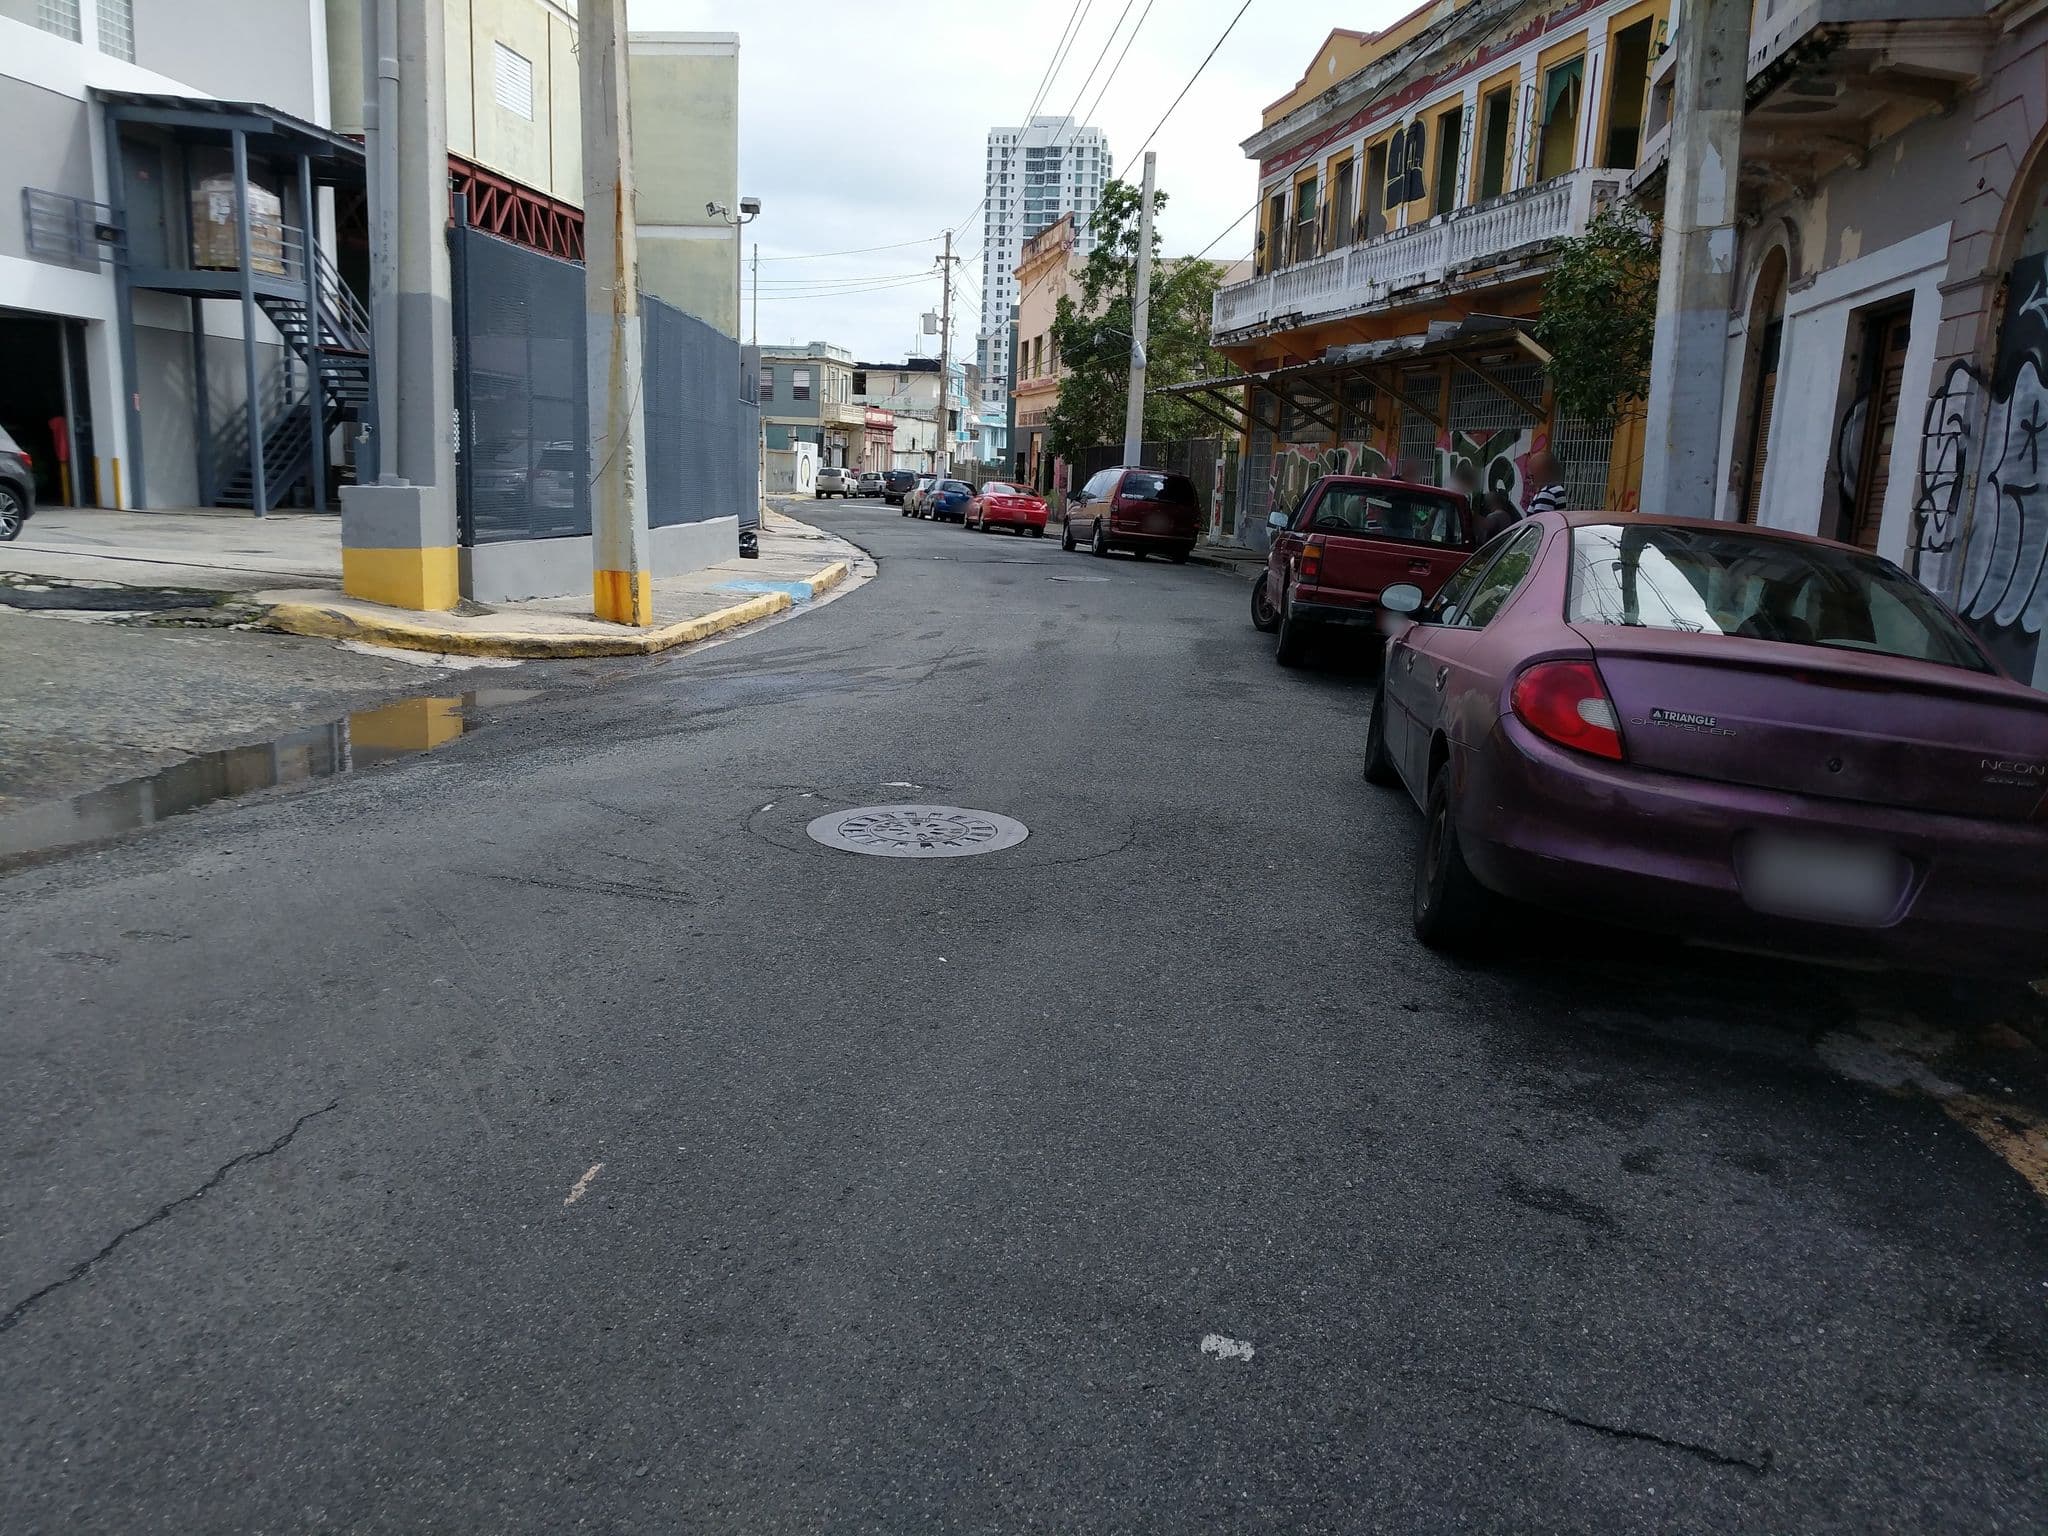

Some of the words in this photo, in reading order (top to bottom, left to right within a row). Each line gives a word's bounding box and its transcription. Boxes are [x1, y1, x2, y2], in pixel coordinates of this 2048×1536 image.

[1631, 717, 1737, 736] CHRYSLER
[1663, 711, 1717, 727] TRIANGLE
[1981, 760, 2045, 776] NEON
